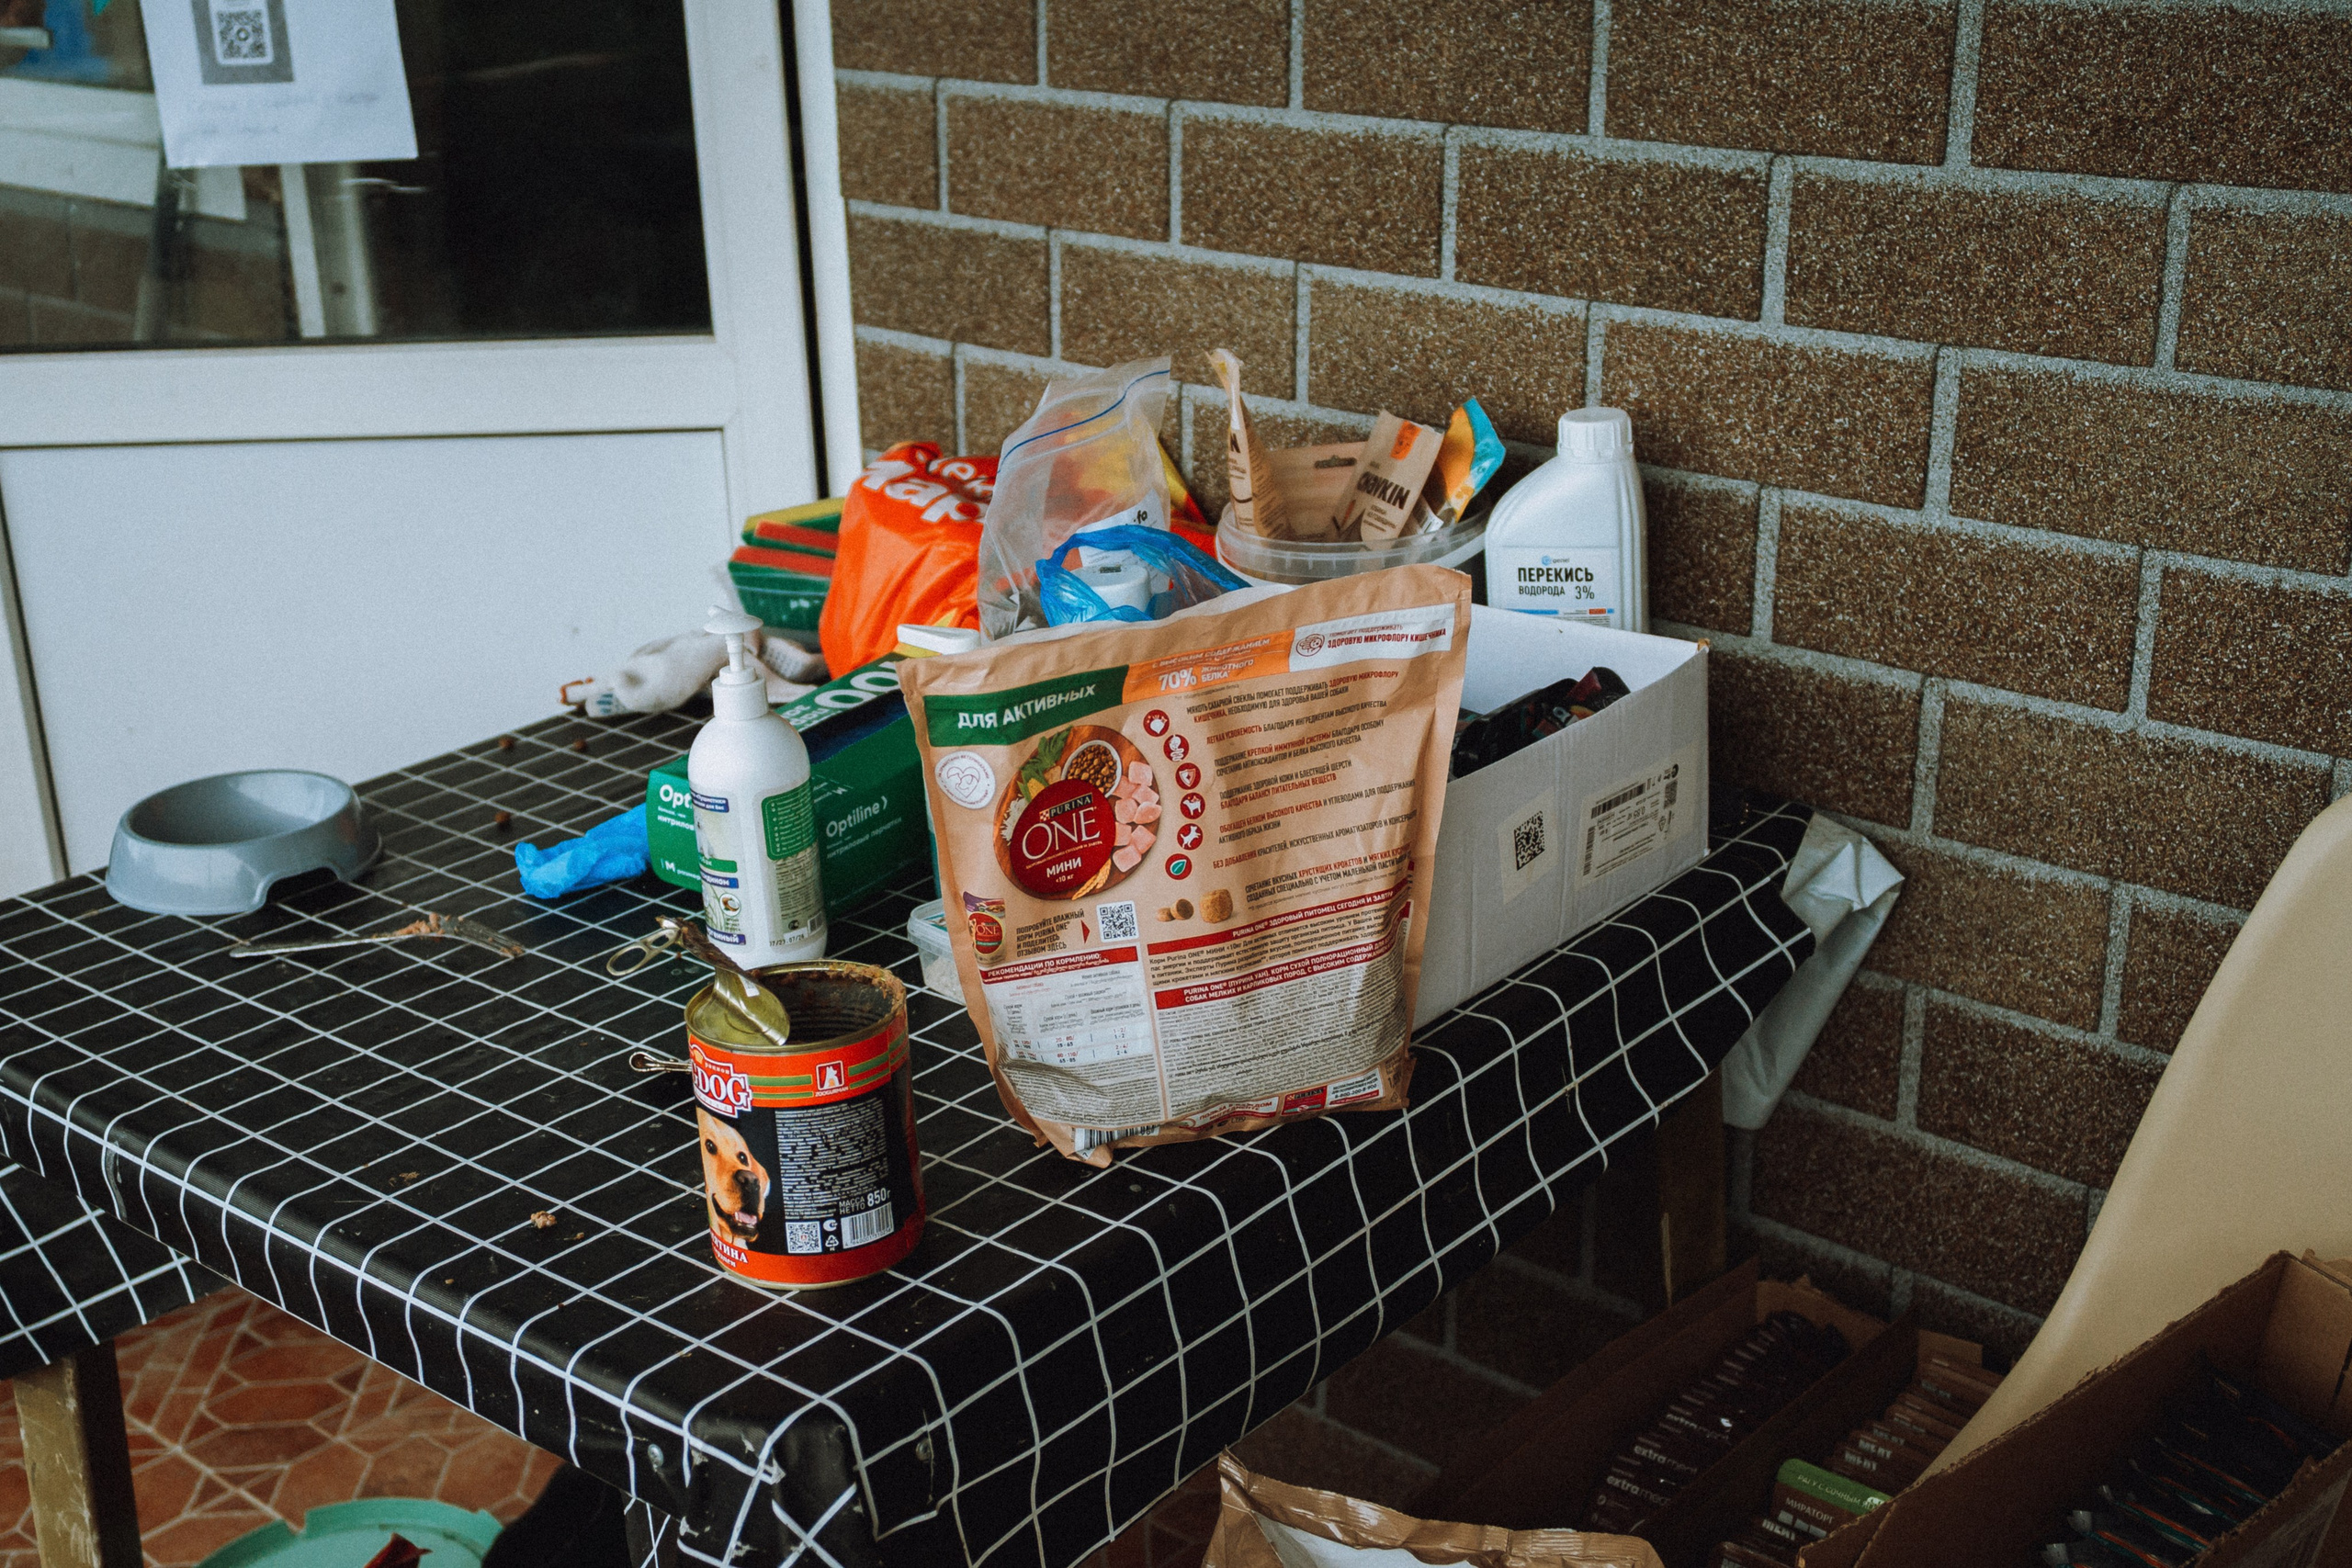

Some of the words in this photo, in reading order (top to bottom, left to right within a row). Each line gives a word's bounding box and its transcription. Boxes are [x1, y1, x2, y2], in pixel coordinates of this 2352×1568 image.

[1518, 567, 1594, 582] ПЕРЕКИСЬ
[1519, 585, 1566, 596] ВОДОРОДА
[1575, 585, 1595, 600] 3%
[1328, 636, 1363, 649] ЗДОРОВУЮ
[1363, 634, 1408, 644] МИКРОФЛОРУ
[1410, 628, 1446, 642] КИШЕЧНИКА
[1159, 668, 1197, 691] 70%
[1201, 660, 1254, 672] ЖИВОТНОГО
[1227, 702, 1268, 716] НЕОБХОДИМУЮ
[1269, 699, 1281, 709] ДЛЯ
[1282, 694, 1310, 706] ЗДОРОВЬЯ
[1310, 690, 1329, 701] ВАШЕЙ
[1329, 686, 1349, 697] СОБАКИ
[1233, 693, 1256, 704] СВЕКЛЫ
[1256, 688, 1284, 701] ПОМОГАЕТ
[1285, 682, 1328, 695] ПОДДЕРЖИВАТЬ
[1329, 675, 1357, 687] ЗДОРОВУЮ
[1359, 671, 1398, 681] МИКРОФЛОРУ
[957, 712, 998, 729] ДЛЯ
[1002, 683, 1097, 726] АКТИВНЫХ
[1263, 720, 1295, 732] БЛАГОДАРЯ
[1295, 711, 1334, 726] ИНГРЕДИЕНТАМ
[1335, 704, 1360, 716] ВЫСОКОГО
[1361, 701, 1387, 710] КАЧЕСТВА
[1214, 750, 1247, 767] ПОДДЕРЖАНИЕ
[1247, 744, 1272, 758] КРЕПКОЙ
[1273, 737, 1306, 752] ИММУННОЙ
[1306, 732, 1331, 745] СИСТЕМЫ
[1331, 724, 1360, 738] БЛАГОДАРЯ
[1361, 719, 1385, 731] ОСОБОМУ
[1293, 747, 1309, 757] БЕЛКА
[1310, 739, 1336, 753] ВЫСОКОГО
[1336, 735, 1362, 747] КАЧЕСТВА
[1219, 784, 1252, 800] ПОДДЕРЖАНИЕ
[1253, 775, 1279, 790] ЗДОРОВОЙ
[1279, 773, 1294, 783] КОЖИ
[1299, 763, 1329, 778] БЛЕСТЯЩЕЙ
[1330, 760, 1351, 771] ШЕРСТИ
[1220, 795, 1249, 809] БЛАГОДАРЯ
[1249, 789, 1271, 801] БАЛАНСУ
[1271, 780, 1311, 795] ПИТАТЕЛЬНЫХ
[1311, 773, 1337, 786] ВЕЩЕСТВ
[826, 803, 880, 838] Optiline
[1050, 796, 1091, 817] PURINA
[1219, 819, 1246, 833] ОБОГАЩЕН
[1246, 813, 1266, 825] БЕЛКОМ
[1266, 807, 1295, 819] ВЫСОКОГО
[1295, 799, 1322, 813] КАЧЕСТВА
[1329, 791, 1363, 806] УГЛЕВОДАМИ
[1364, 788, 1376, 798] ДЛЯ
[1023, 807, 1101, 860] ONE
[1213, 860, 1224, 869] БЕЗ
[1225, 850, 1257, 868] ДОБАВЛЕНИЯ
[1289, 830, 1334, 849] ИСКУССТВЕННЫХ
[1335, 820, 1383, 838] АРОМАТИЗАТОРОВ
[1218, 829, 1245, 844] АКТИВНОГО
[1246, 826, 1262, 837] ОБРАЗА
[1263, 820, 1281, 831] ЖИЗНИ
[1046, 857, 1082, 878] МИНИ
[1245, 878, 1272, 893] СОЧЕТАНИЕ
[1272, 872, 1297, 885] ВКУСНЫХ
[1298, 863, 1333, 878] ХРУСТЯЩИХ
[1334, 857, 1363, 870] КРОКЕТОВ
[1368, 851, 1391, 862] МЯГКИХ
[1247, 887, 1276, 903] СОЗДАННЫХ
[1276, 877, 1313, 894] СПЕЦИАЛЬНО
[1319, 871, 1342, 884] УЧЕТОМ
[1342, 862, 1377, 877] МАЛЕНЬКОЙ
[1016, 919, 1052, 934] ПОПРОБУЙТЕ
[1053, 908, 1084, 922] ВЛАЖНЫЙ
[1232, 926, 1254, 937] PURINA
[1269, 911, 1303, 926] ЗДОРОВЫЙ
[1304, 905, 1336, 918] ПИТОМЕЦ
[1337, 899, 1365, 910] СЕГОДНЯ
[1016, 932, 1034, 942] КОРМ
[1035, 927, 1055, 938] PURINA
[1016, 947, 1046, 957] ОТЗЫВОМ
[1047, 942, 1067, 952] ЗДЕСЬ
[1023, 934, 1060, 949] ПОДЕЛИТЕСЬ
[1149, 956, 1166, 965] Корм
[1167, 953, 1187, 963] Purina
[1206, 946, 1225, 955] МИНИ
[1278, 924, 1308, 935] отличается
[1310, 919, 1334, 928] высоким
[1335, 913, 1360, 925] уровнем
[1162, 961, 1186, 972] энергии
[1193, 952, 1235, 965] поддерживает
[1270, 935, 1290, 946] защиту
[1291, 929, 1319, 941] организма
[1352, 916, 1373, 925] Вашей
[988, 961, 1044, 977] РЕКОМЕНДАЦИИ
[1056, 953, 1102, 965] КОРМЛЕНИЮ:
[1171, 974, 1204, 985] крокетами
[1210, 966, 1235, 976] мягкими
[1292, 943, 1317, 955] помогает
[1317, 934, 1359, 949] поддерживать
[1185, 964, 1214, 975] Эксперты
[1216, 959, 1237, 969] Пурина
[1294, 931, 1340, 948] полнорационное
[1341, 926, 1365, 936] питание
[1183, 986, 1209, 996] PURINA
[1271, 965, 1289, 976] КОРМ
[1290, 959, 1310, 971] СУХОЙ
[1311, 942, 1374, 964] ПОЛНОРАЦИОННЫЙ
[1184, 995, 1207, 1003] СОБАК
[1208, 989, 1236, 998] МЕЛКИХ
[1242, 976, 1283, 991] КАРЛИКОВЫХ
[1313, 959, 1345, 971] ВЫСОКИМ
[815, 1086, 849, 1098] ZOOGURMAN
[838, 1196, 865, 1208] МАССА
[839, 1202, 865, 1214] НЕТТО
[1607, 1475, 1640, 1495] extra
[1798, 1473, 1818, 1487] РАГУ
[1826, 1486, 1861, 1507] СОЧНЫМ
[1786, 1496, 1835, 1525] МИРАТОРГ
